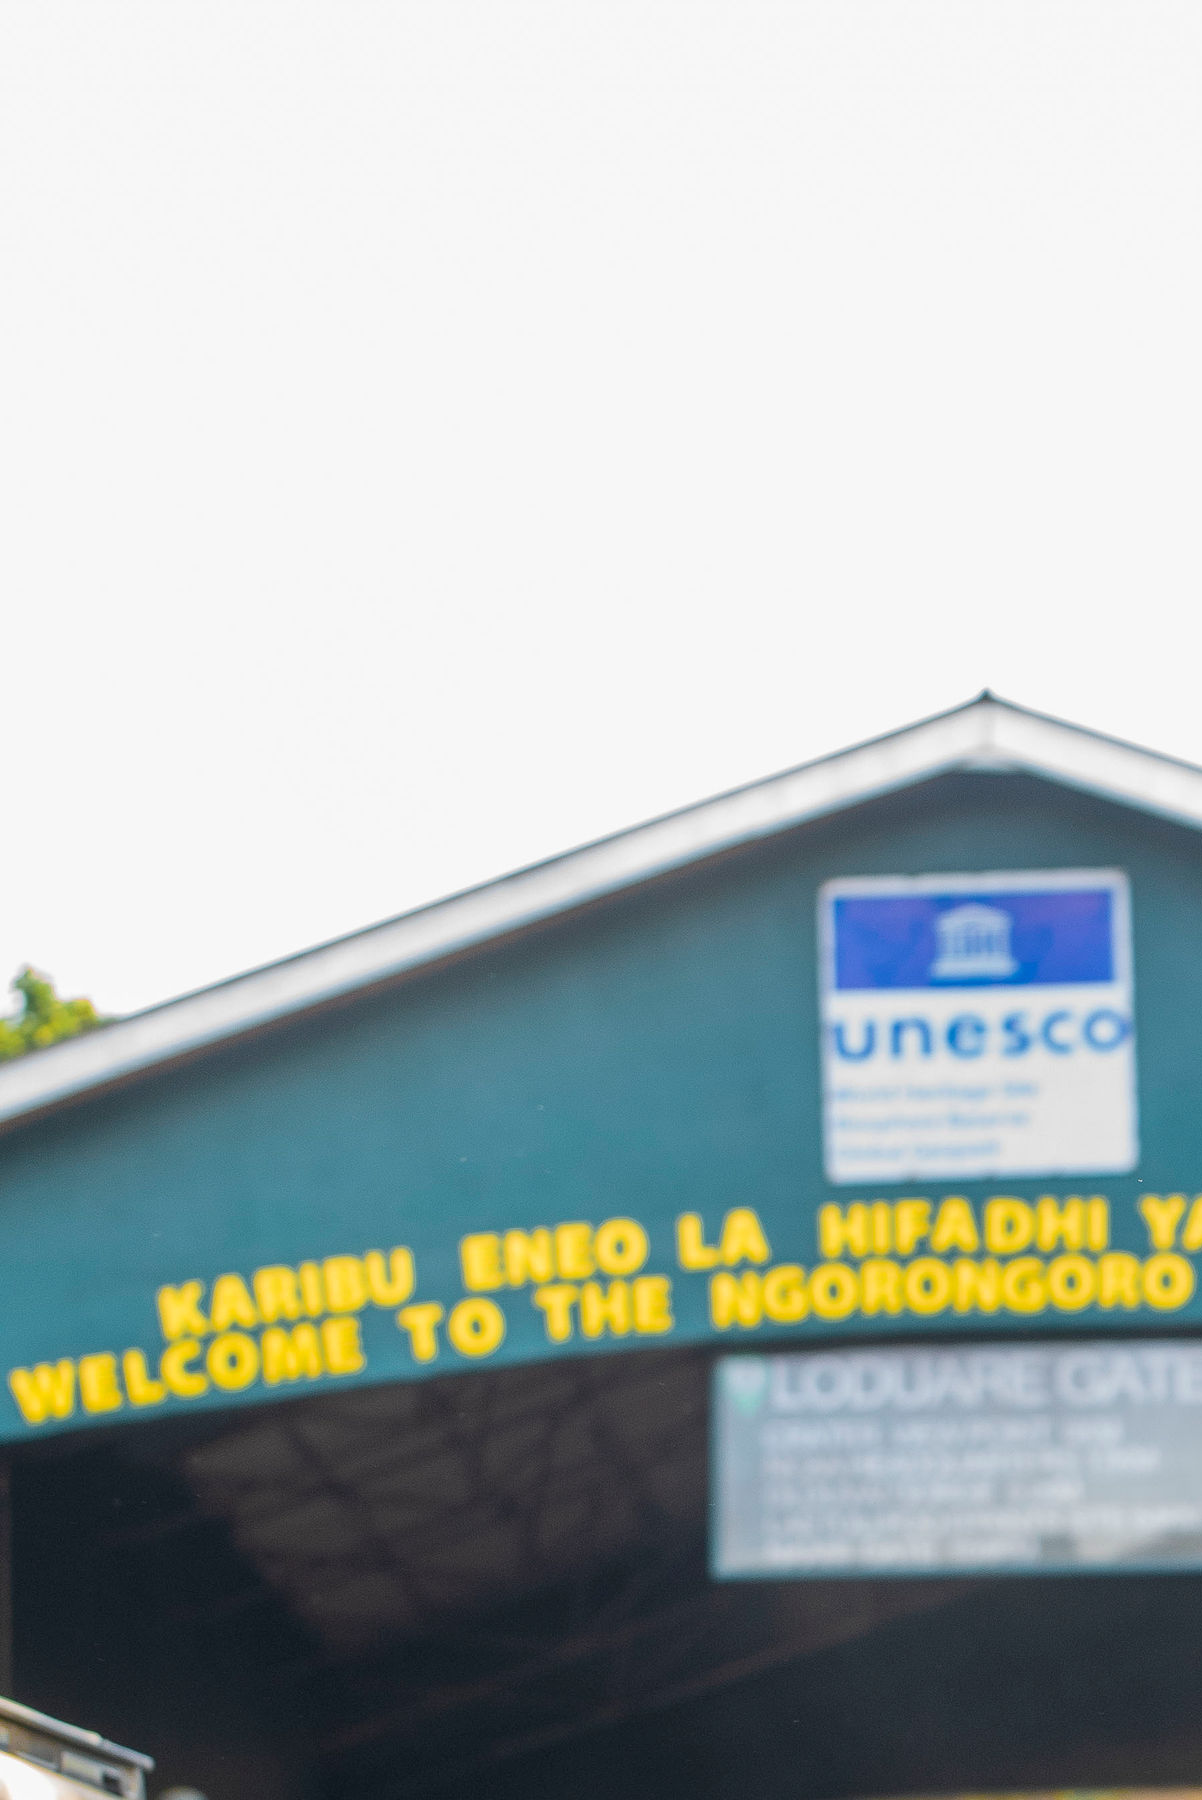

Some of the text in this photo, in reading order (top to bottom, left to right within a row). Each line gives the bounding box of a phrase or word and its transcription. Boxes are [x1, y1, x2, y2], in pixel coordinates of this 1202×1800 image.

[833, 1008, 1132, 1061] unesco
[11, 1315, 363, 1422] WELCOME
[399, 1298, 503, 1360] TO
[533, 1275, 671, 1340] THE
[712, 1251, 1193, 1328] NGORONGORO
[159, 1249, 413, 1342] KARIBU
[462, 1220, 646, 1291] ENEO
[679, 1210, 768, 1269] LA
[820, 1198, 1107, 1259] HIFADHI
